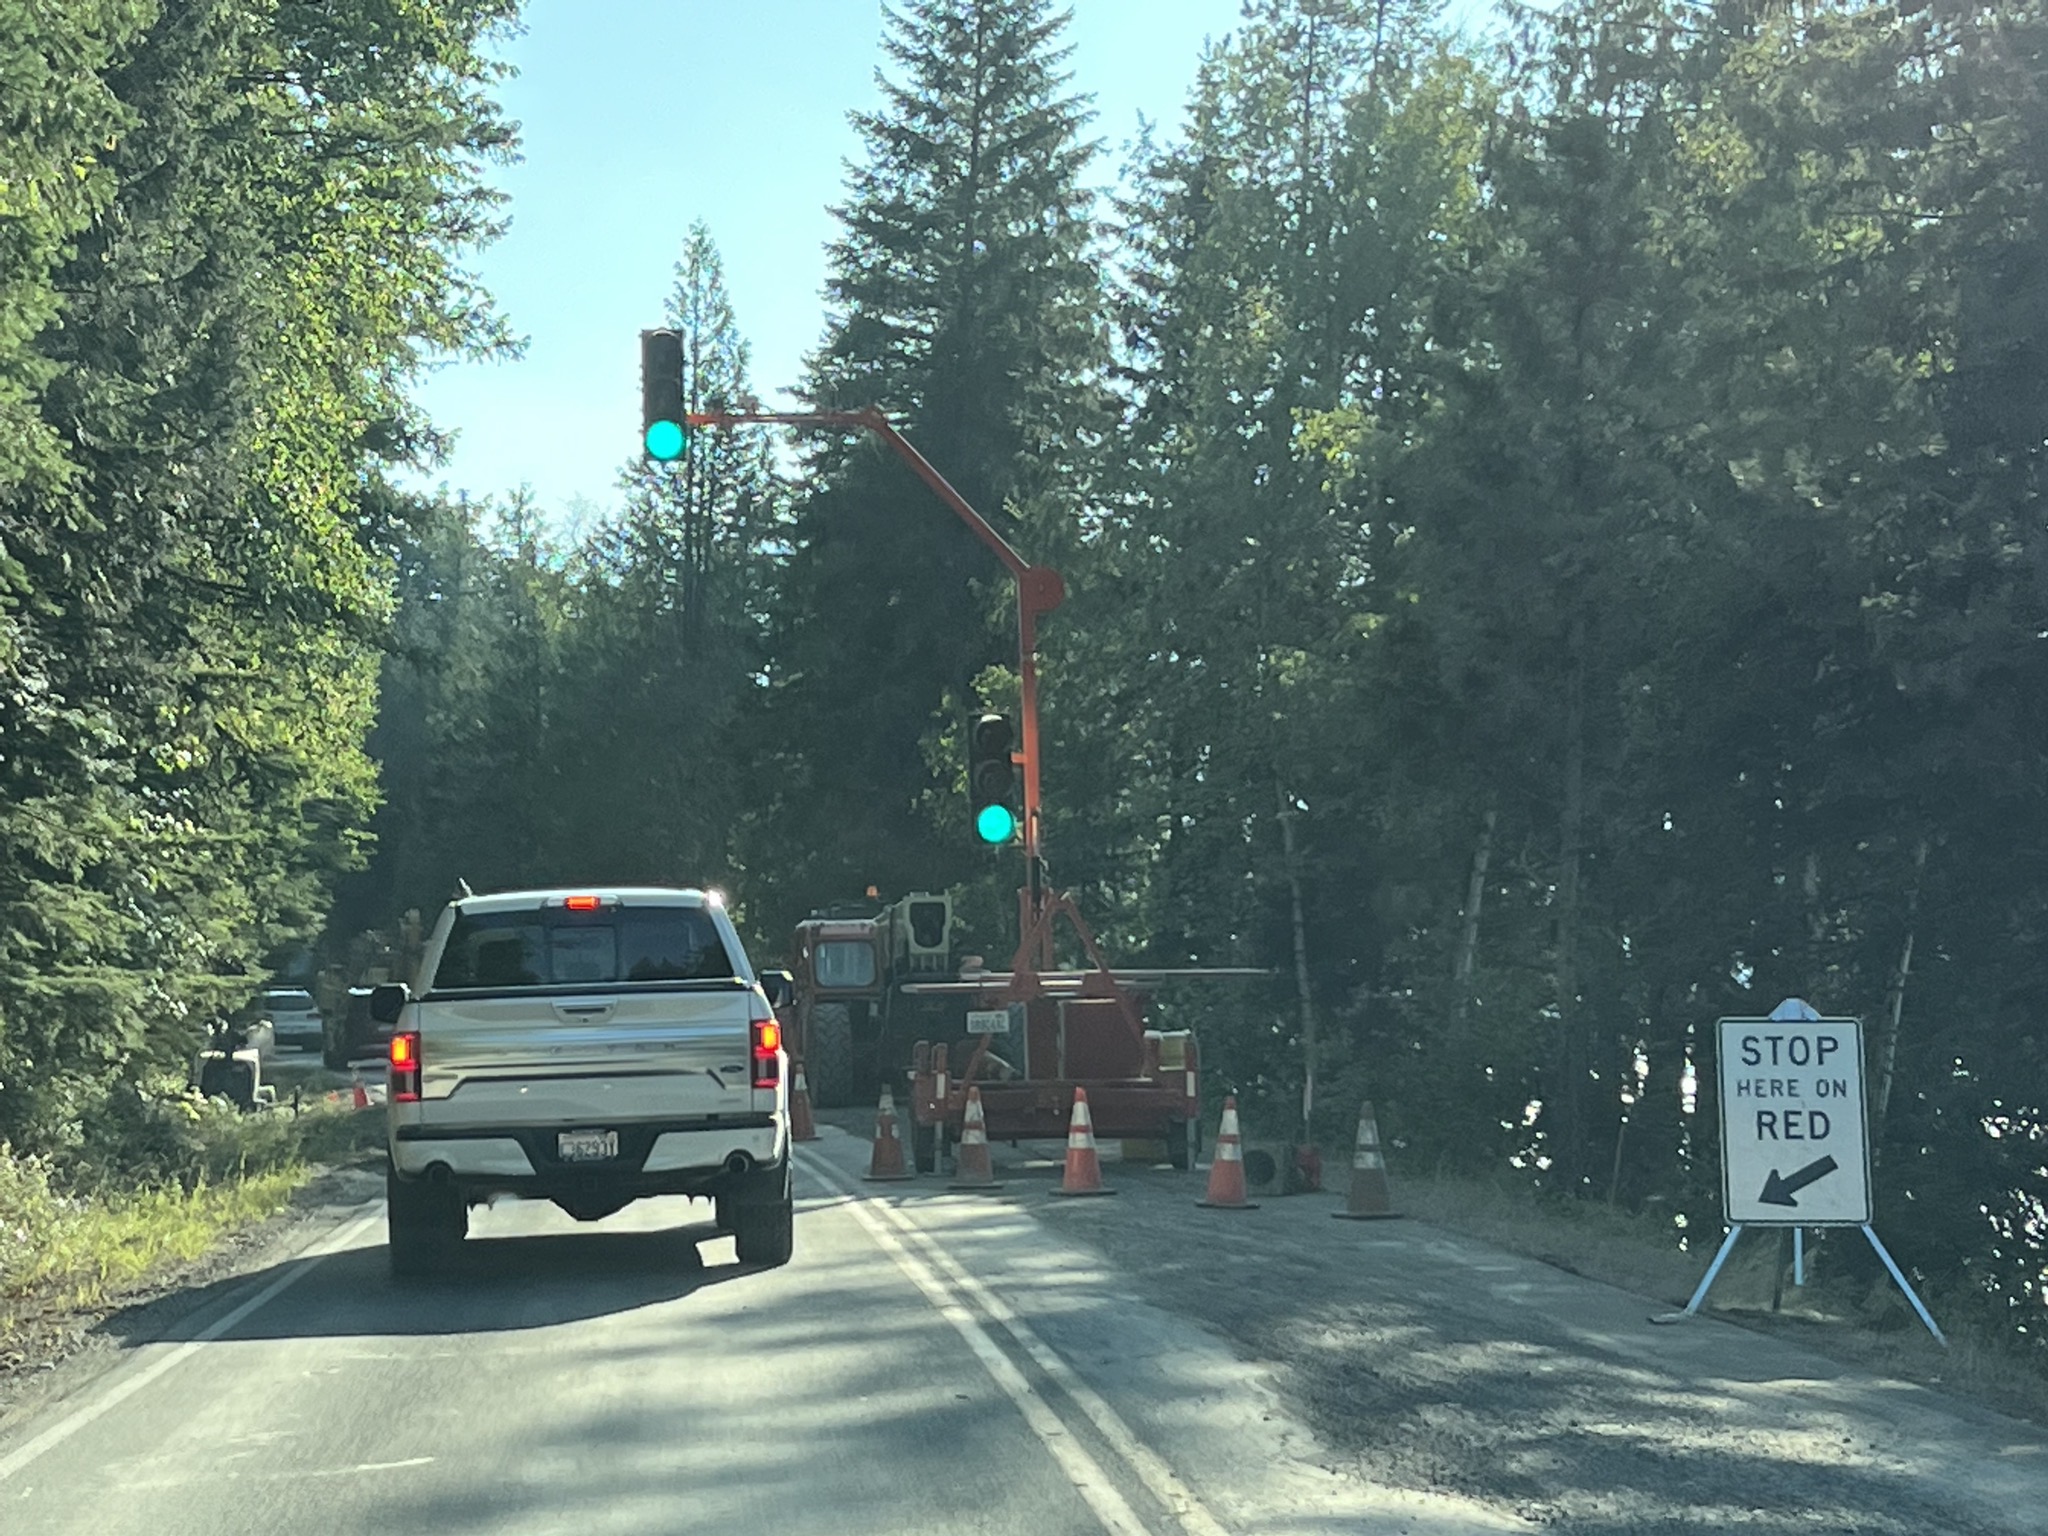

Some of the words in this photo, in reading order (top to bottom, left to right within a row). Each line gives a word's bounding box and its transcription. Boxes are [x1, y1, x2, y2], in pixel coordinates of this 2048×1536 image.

[1741, 1035, 1839, 1066] STOP
[1736, 1078, 1800, 1098] HERE
[1815, 1078, 1847, 1098] ON
[1756, 1110, 1831, 1141] RED
